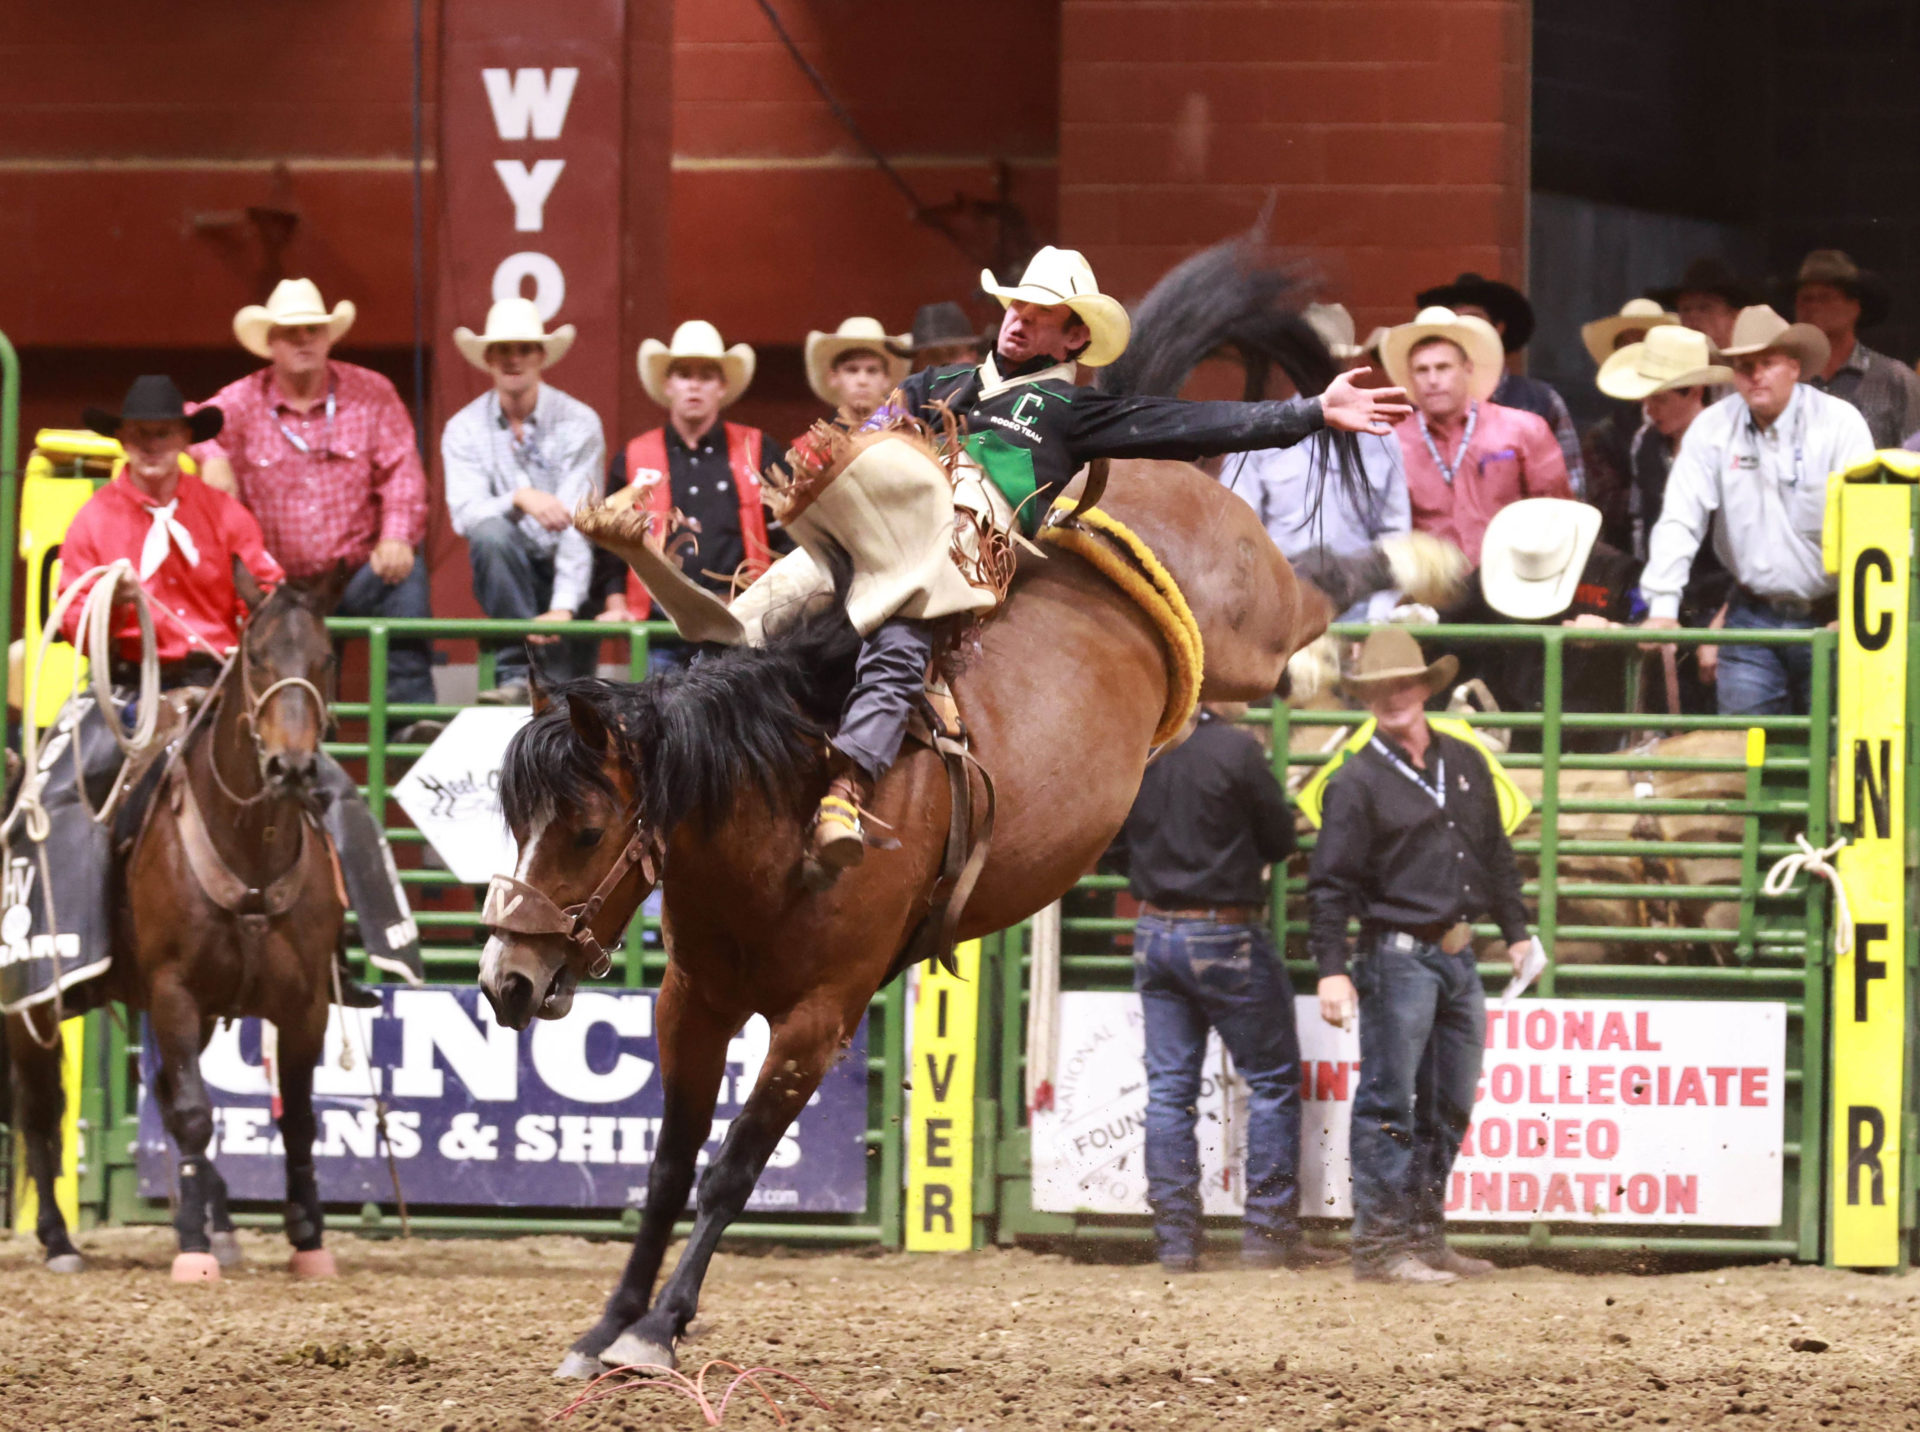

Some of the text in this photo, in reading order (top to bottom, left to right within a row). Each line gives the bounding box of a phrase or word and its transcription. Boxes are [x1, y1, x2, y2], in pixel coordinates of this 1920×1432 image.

[481, 67, 580, 324] WYO
[990, 415, 1043, 444] RODEO TEAM
[1846, 547, 1894, 1207] CNFR
[1485, 1009, 1661, 1051] TIONAL
[205, 1106, 802, 1168] ENS & SHIS
[1444, 1171, 1698, 1214] UNDATION
